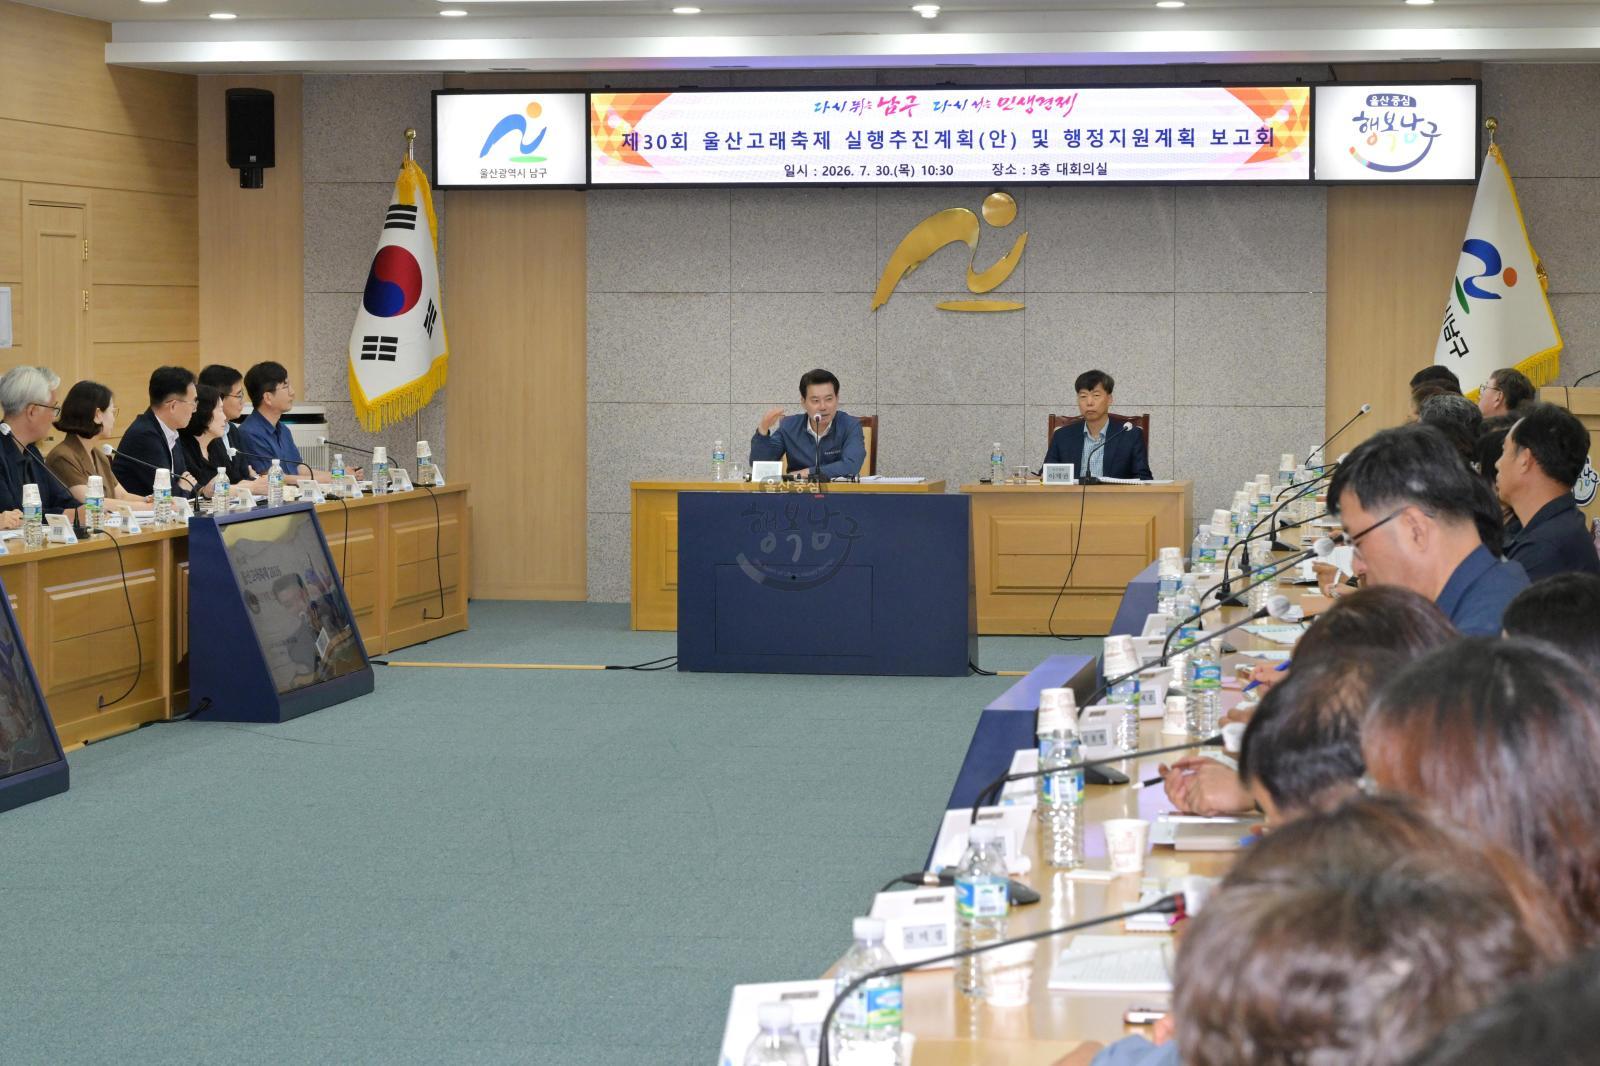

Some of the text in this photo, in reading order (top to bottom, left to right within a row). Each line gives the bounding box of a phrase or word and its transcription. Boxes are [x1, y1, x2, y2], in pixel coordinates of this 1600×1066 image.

[814, 92, 1079, 118] 다시 뛰는 남구 다시 서는 민생경제
[1370, 95, 1411, 107] 울산중심
[621, 127, 1275, 151] 제30회 울산고래축제 실행추진계획(안) 및 행정지원계획 보고회
[1351, 110, 1443, 153] 행복남구
[480, 168, 547, 179] 울산광역시 남구
[784, 164, 808, 178] 일시
[822, 165, 854, 177] 2026.
[859, 165, 870, 176] 7.
[876, 163, 915, 178] 30.(목)
[921, 164, 954, 176] 10:30
[992, 162, 1017, 177] 장소
[1030, 162, 1051, 176] 3층
[1056, 162, 1108, 176] 대회의실
[1443, 318, 1470, 358] 남구
